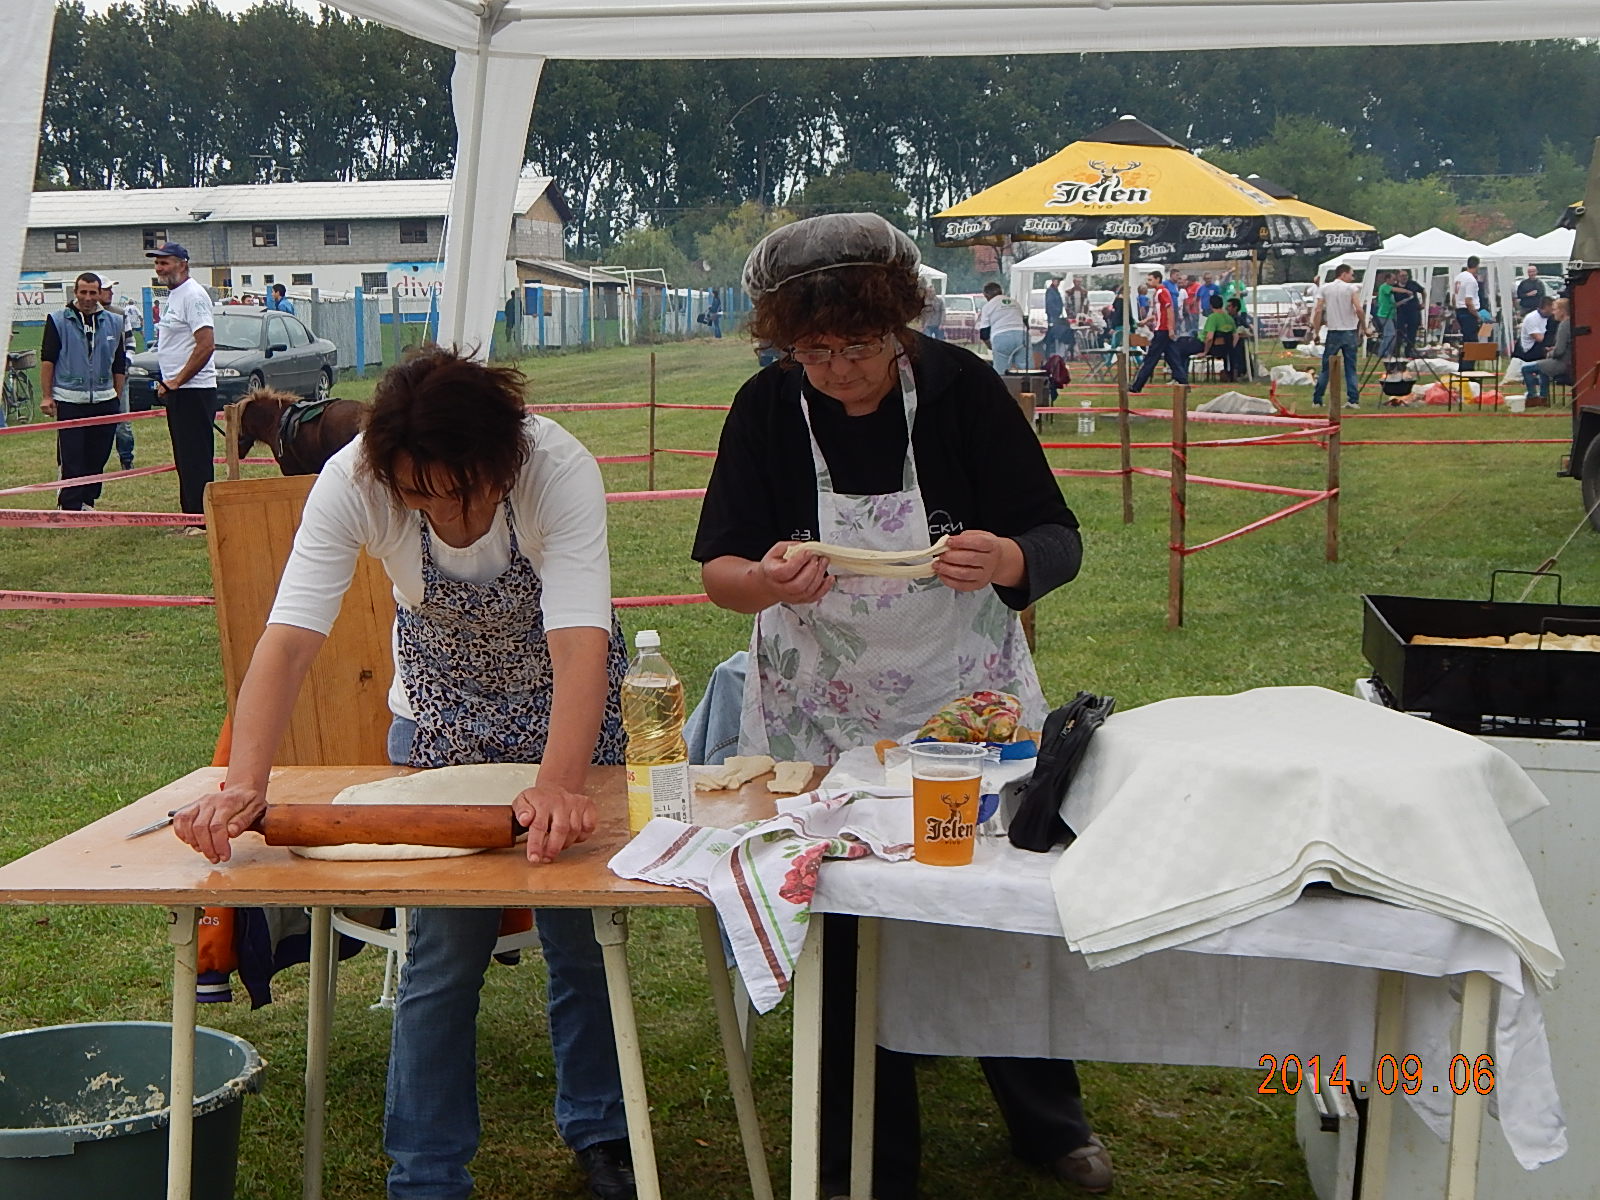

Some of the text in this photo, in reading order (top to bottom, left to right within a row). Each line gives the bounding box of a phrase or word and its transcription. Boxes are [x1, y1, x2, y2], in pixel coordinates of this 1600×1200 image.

[1046, 182, 1150, 206] Jelen
[945, 222, 982, 238] Jelen
[1023, 219, 1060, 232] Jelen
[1104, 221, 1143, 235] Jelen
[1187, 222, 1226, 239] Jelen
[926, 817, 974, 841] Jelen
